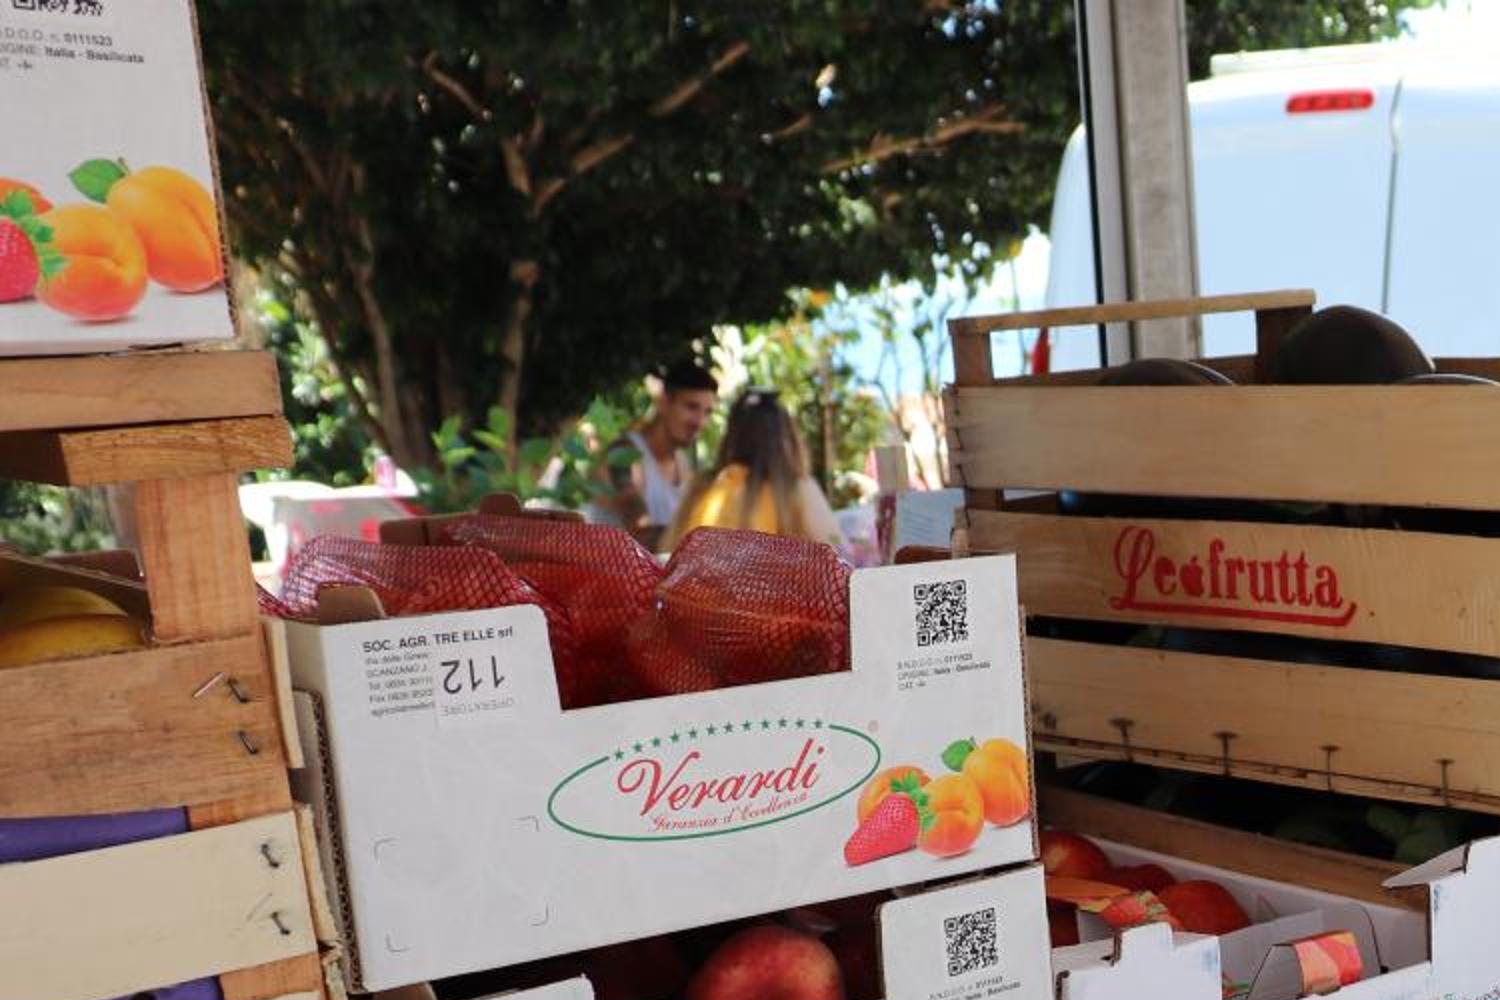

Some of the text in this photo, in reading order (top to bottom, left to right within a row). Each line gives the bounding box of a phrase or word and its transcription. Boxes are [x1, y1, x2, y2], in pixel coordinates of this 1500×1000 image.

[45, 46, 75, 58] Italia
[86, 49, 145, 63] Basilicata
[399, 635, 430, 649] AGR.
[434, 631, 459, 645] TRE
[463, 628, 495, 642] ELLE
[441, 655, 505, 695] 112
[618, 738, 825, 817] Verardi
